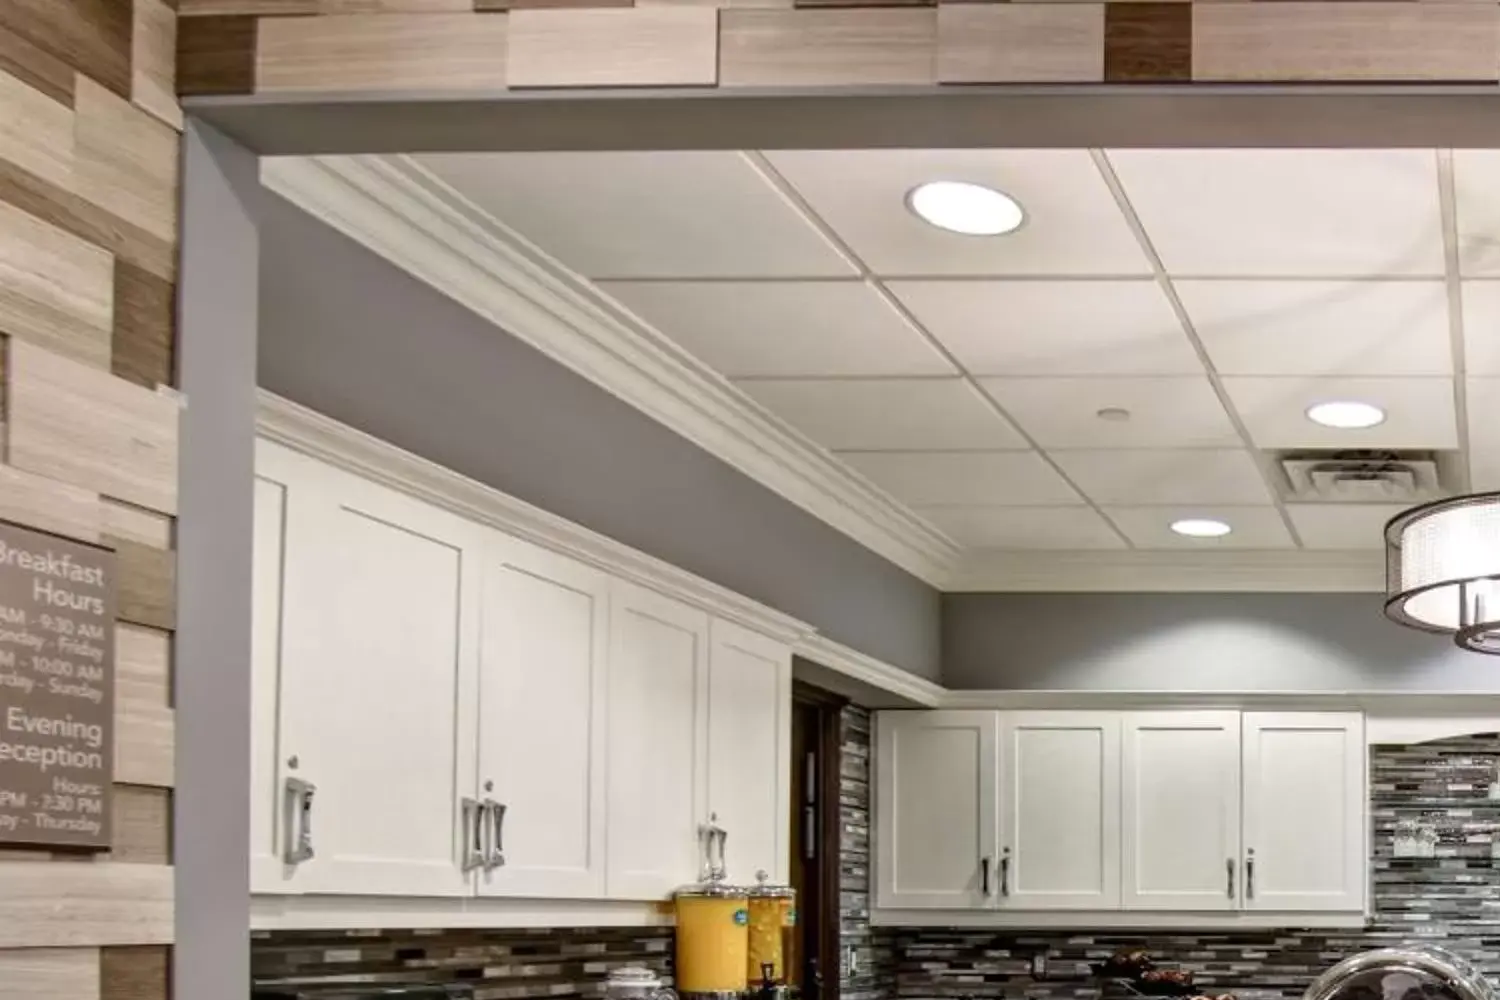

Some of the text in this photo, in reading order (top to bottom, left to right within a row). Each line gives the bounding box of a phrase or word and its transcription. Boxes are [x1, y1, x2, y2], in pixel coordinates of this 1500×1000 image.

[33, 577, 104, 615] Hours
[78, 623, 104, 640] AM
[58, 634, 104, 663] Friday
[32, 655, 74, 677] 10:00
[77, 664, 104, 681] AM
[48, 677, 104, 704] Sunday
[7, 706, 102, 748] Evening
[77, 797, 102, 814] PM
[31, 811, 102, 836] Thursday
